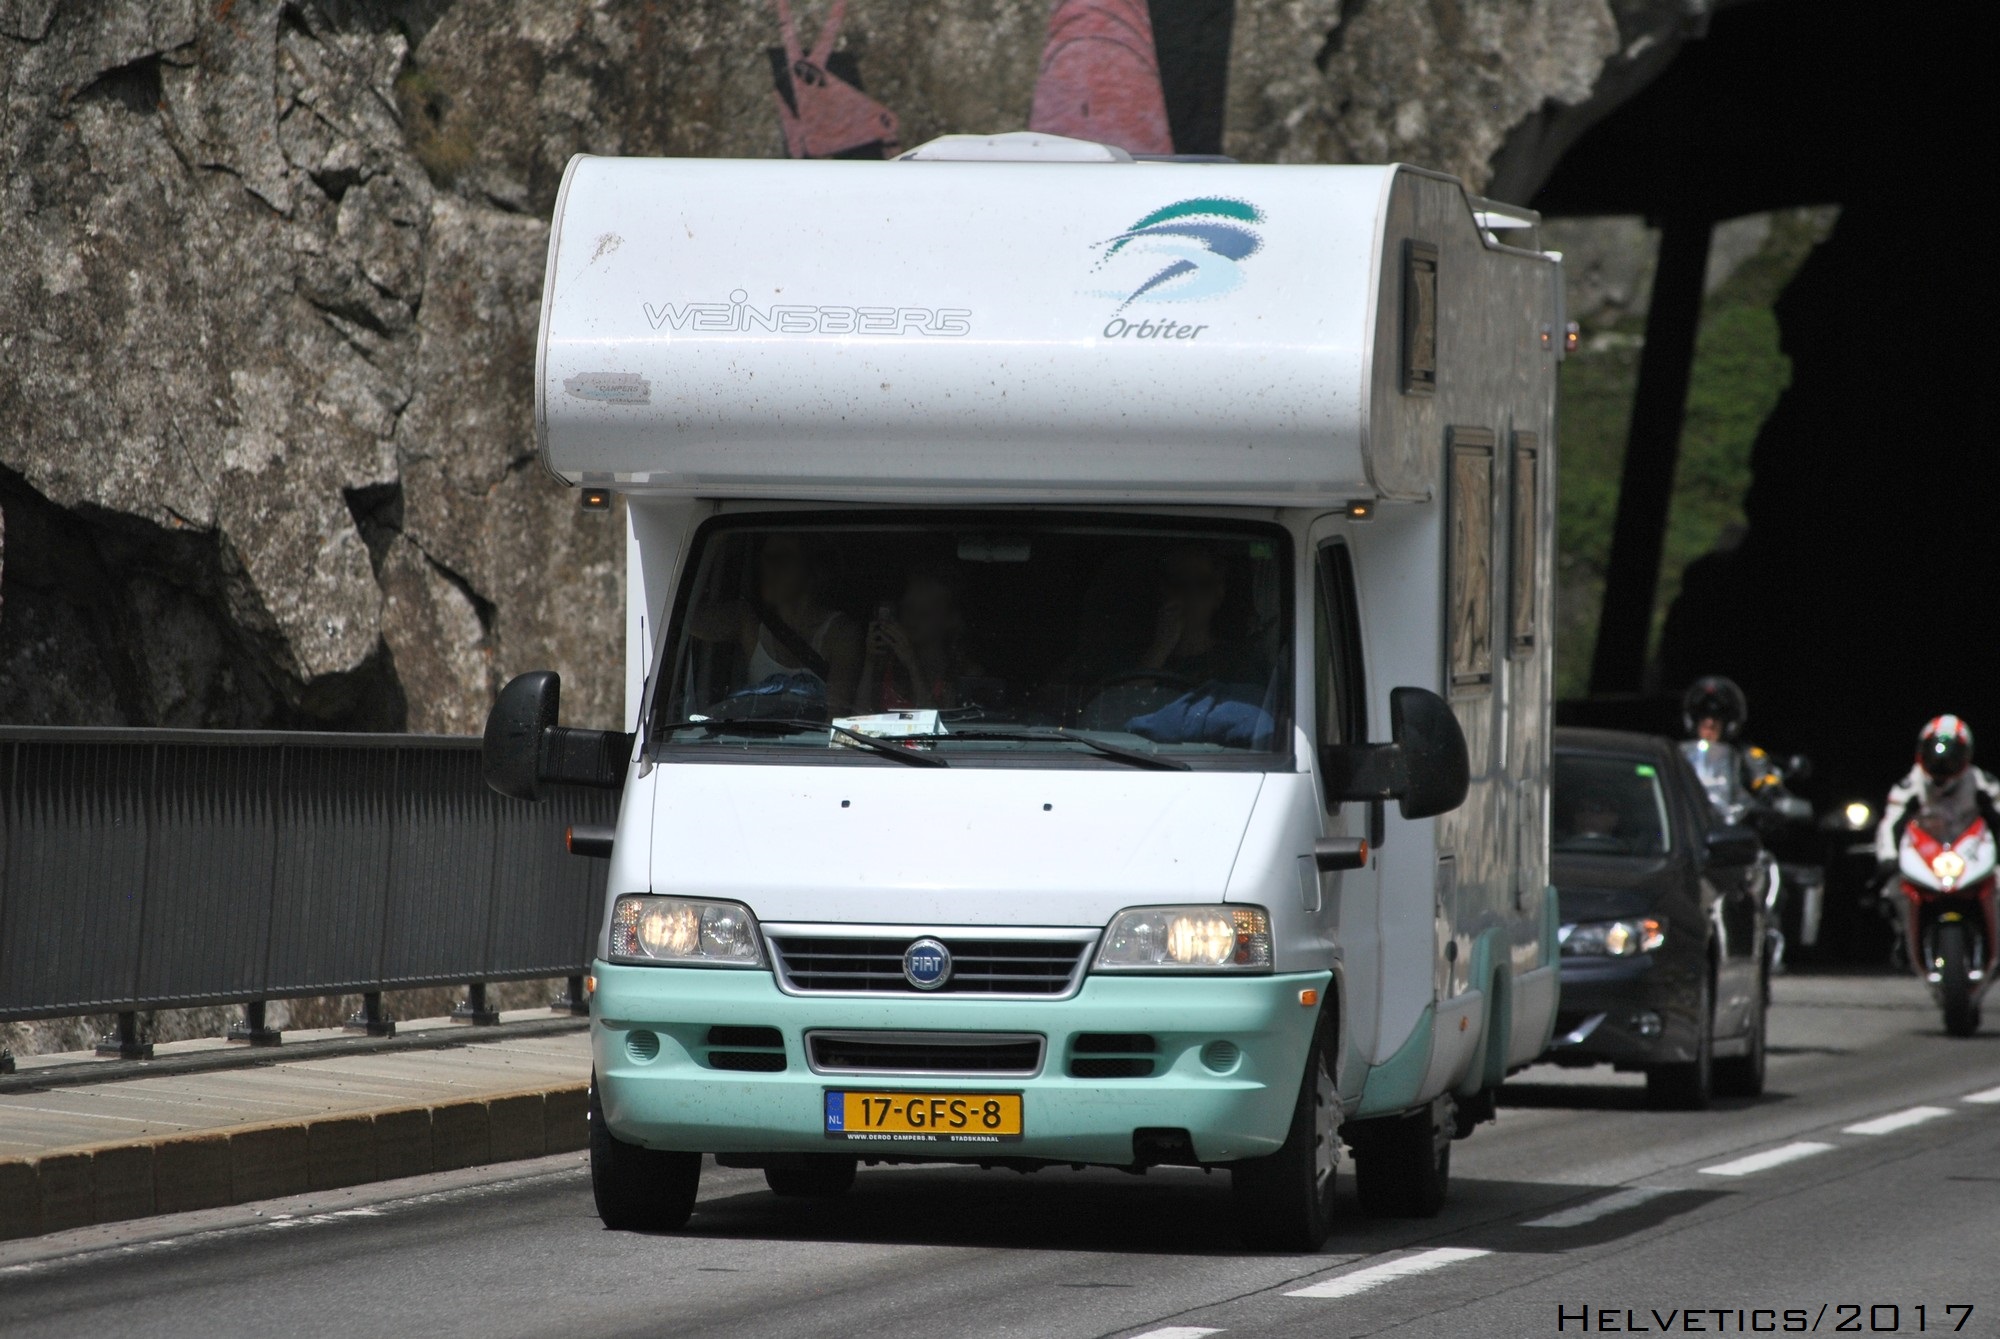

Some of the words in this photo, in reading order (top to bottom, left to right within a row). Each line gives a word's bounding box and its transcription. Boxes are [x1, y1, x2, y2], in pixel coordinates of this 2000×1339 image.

[1103, 318, 1209, 339] Orbiter
[912, 956, 941, 971] FIAT
[828, 1115, 842, 1125] NL
[861, 1097, 1001, 1129] 17-GFS-8
[893, 1134, 937, 1142] CAMPERS.NL
